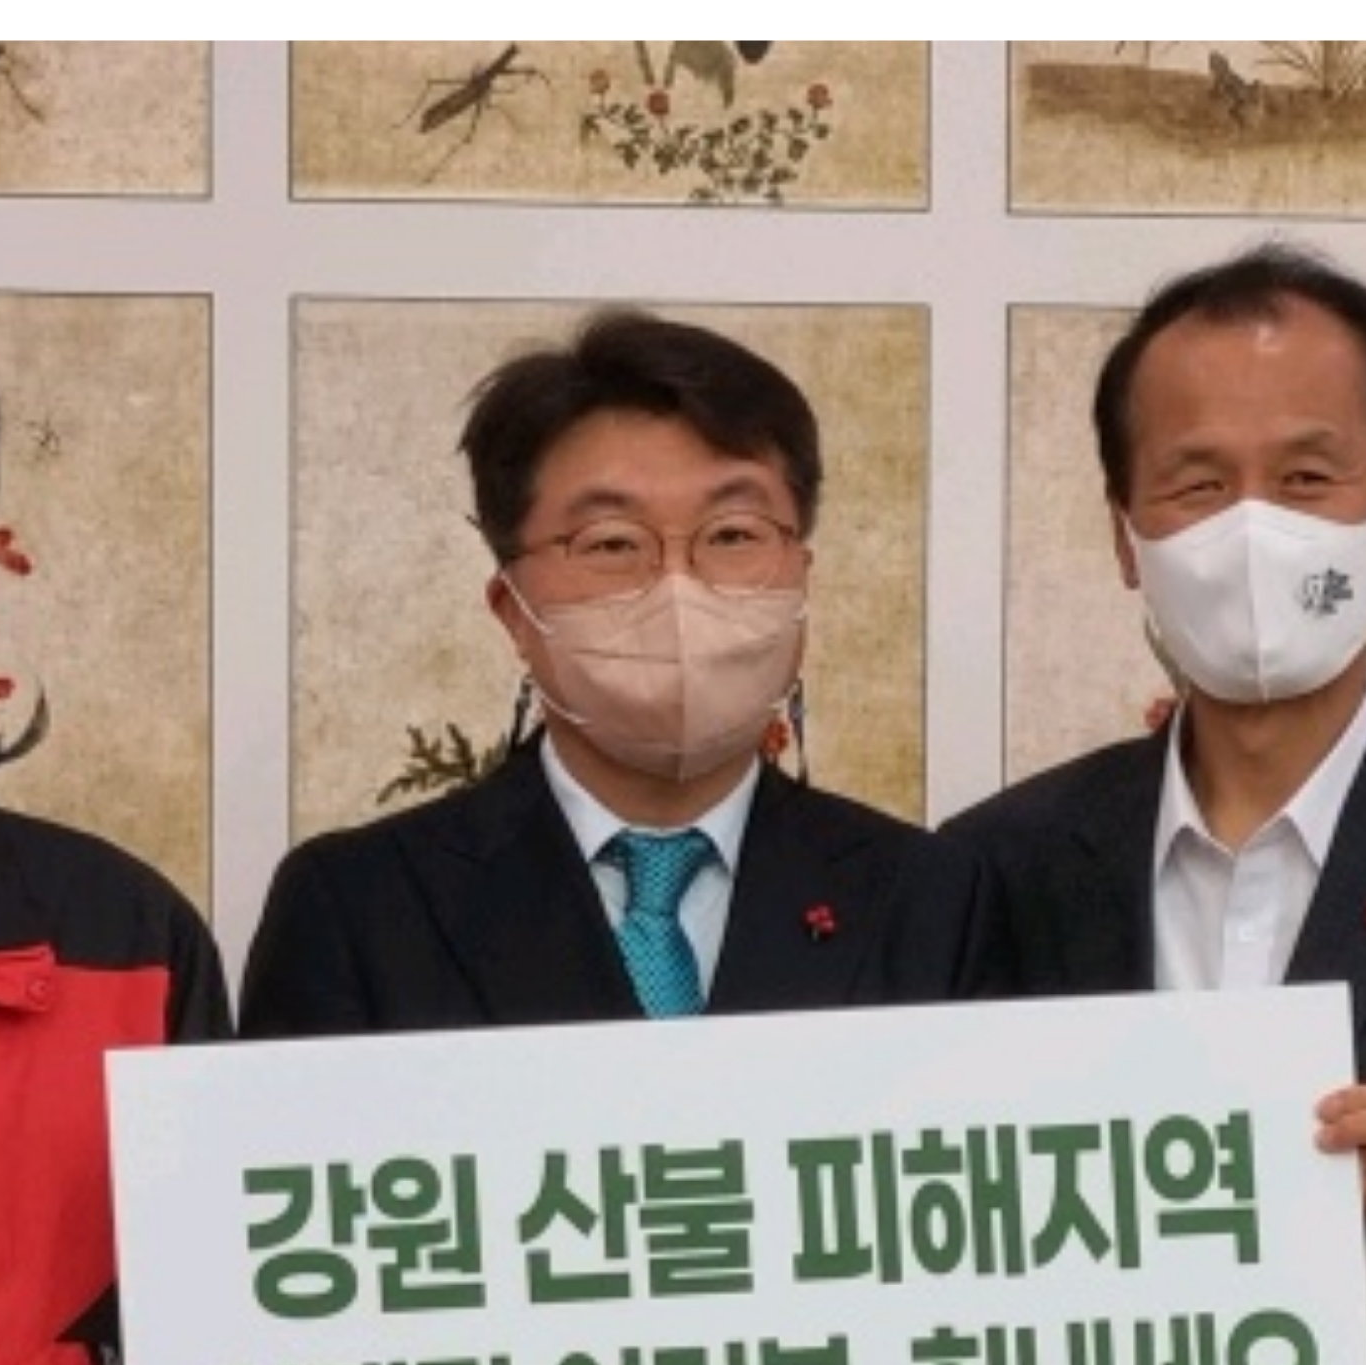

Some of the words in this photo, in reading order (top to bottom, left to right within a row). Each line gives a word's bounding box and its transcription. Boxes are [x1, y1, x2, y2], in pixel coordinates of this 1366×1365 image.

[241, 1153, 489, 1319] 강원
[518, 1140, 755, 1303] 산불
[789, 1111, 1261, 1283] 피해지역
